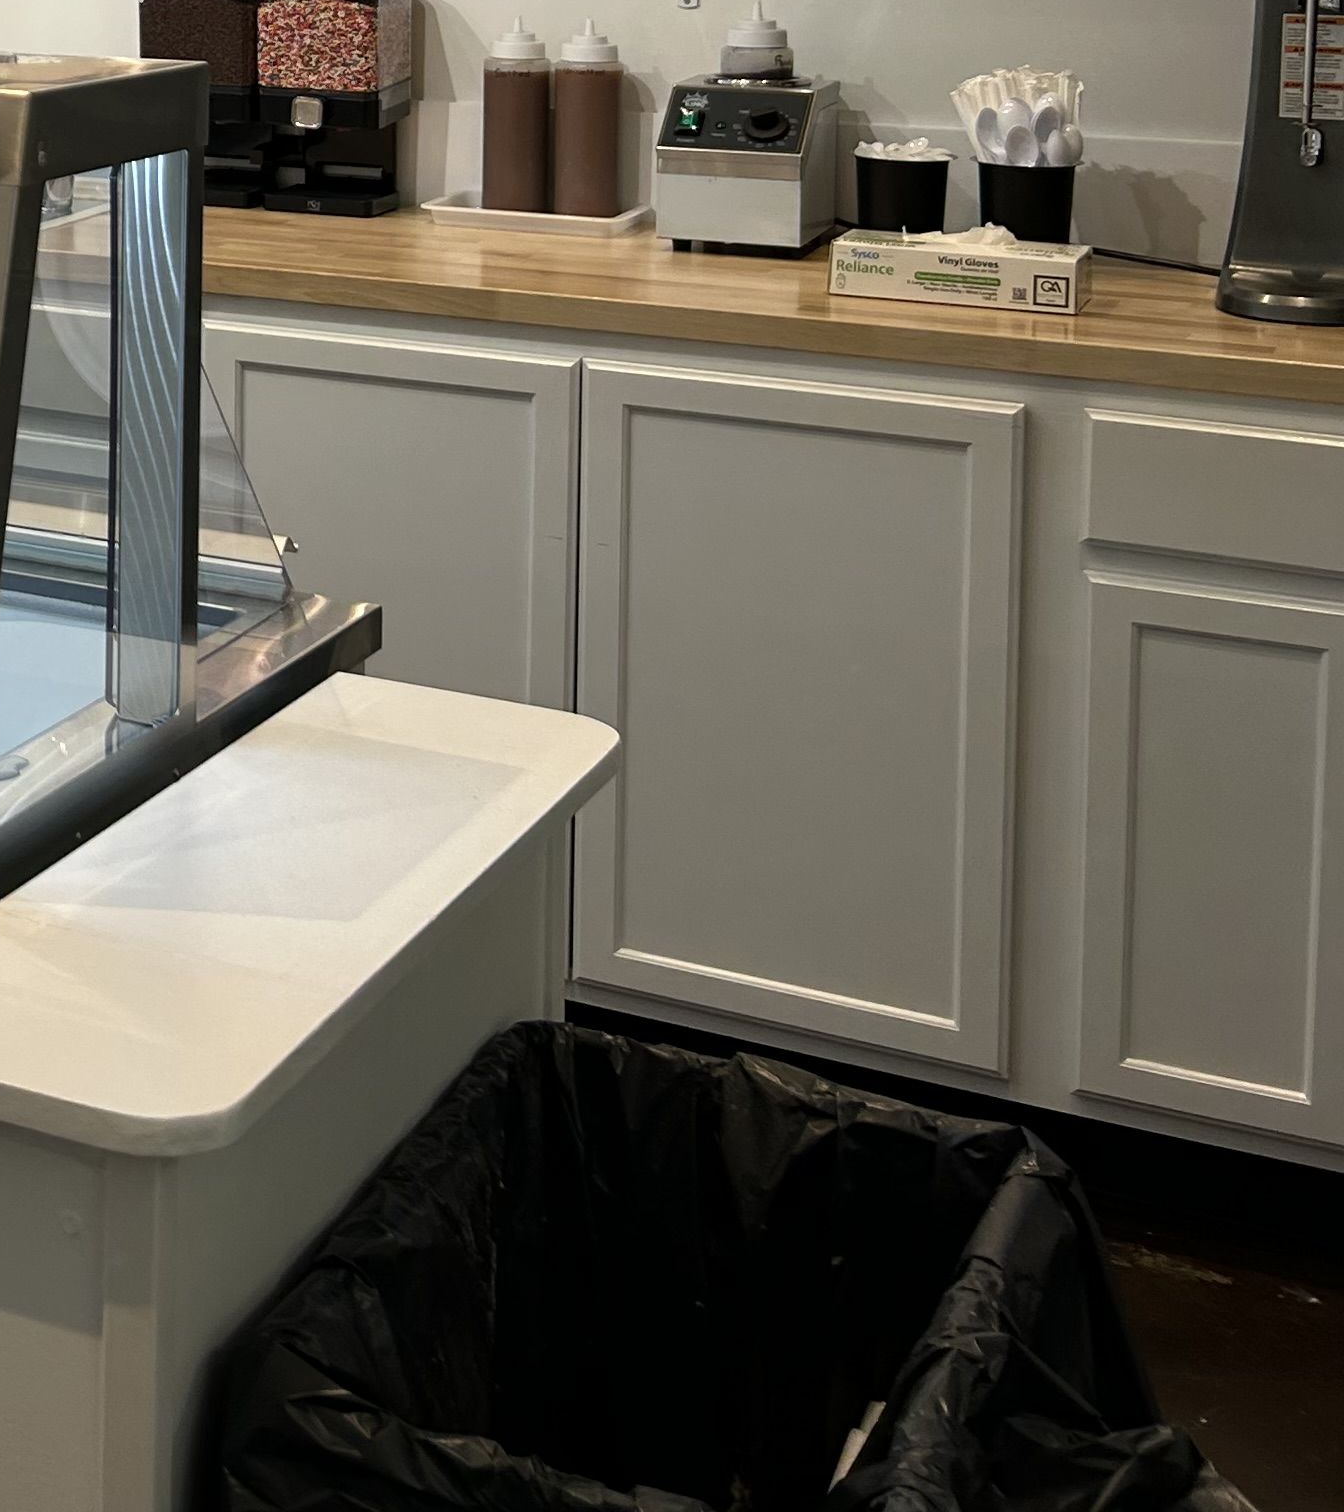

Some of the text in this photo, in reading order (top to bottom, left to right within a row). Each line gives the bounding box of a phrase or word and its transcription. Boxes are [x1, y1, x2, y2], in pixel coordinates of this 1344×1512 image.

[835, 259, 895, 276] Reliance
[937, 255, 1000, 269] Vinyl Gloves
